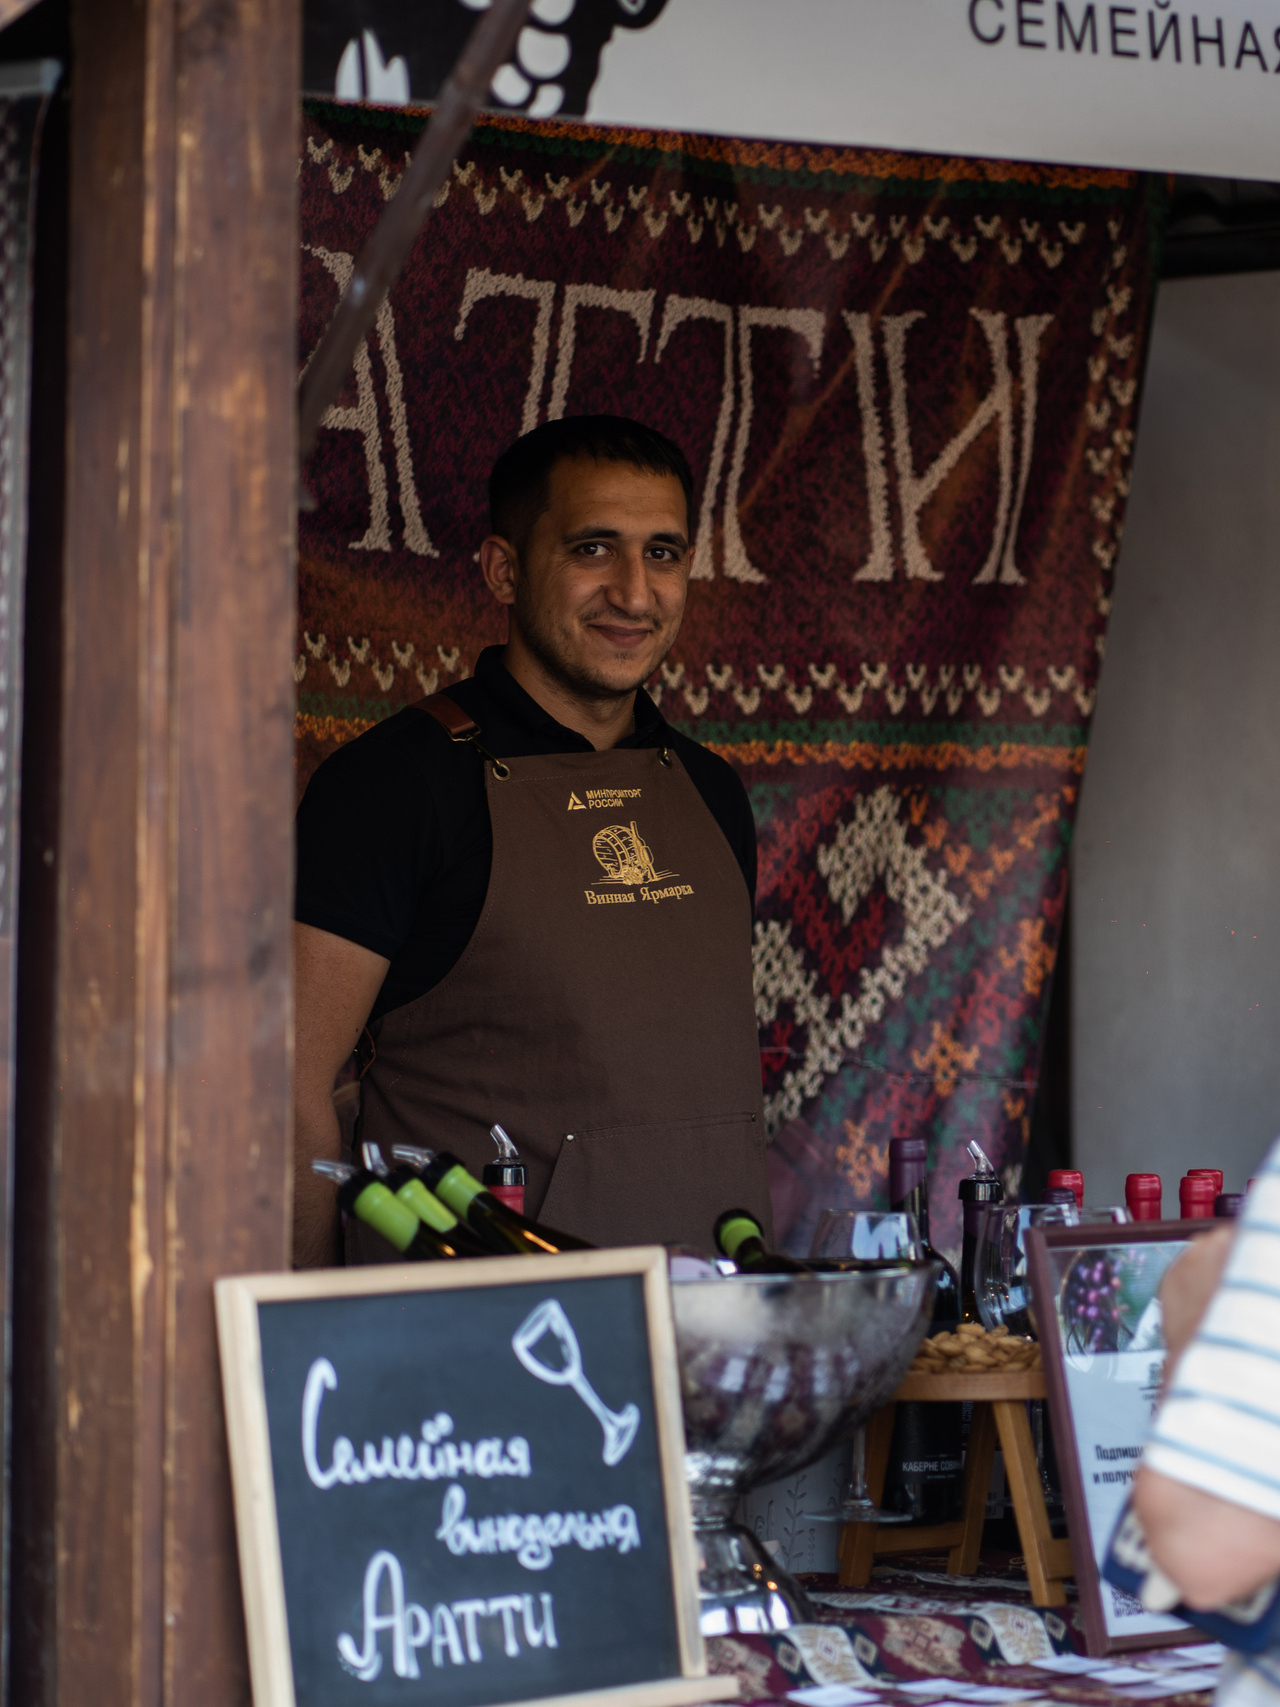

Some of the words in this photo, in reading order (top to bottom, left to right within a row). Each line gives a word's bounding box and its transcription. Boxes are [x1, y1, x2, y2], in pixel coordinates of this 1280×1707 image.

[586, 788, 642, 800] МИНПРОМТОРГ
[588, 799, 624, 810] РОССИИ
[584, 890, 637, 905] Винная
[640, 884, 695, 904] Ярмарка
[302, 1357, 532, 1490] Семейная
[902, 1461, 939, 1472] КАБЕРНЕ
[1092, 1472, 1100, 1484] и
